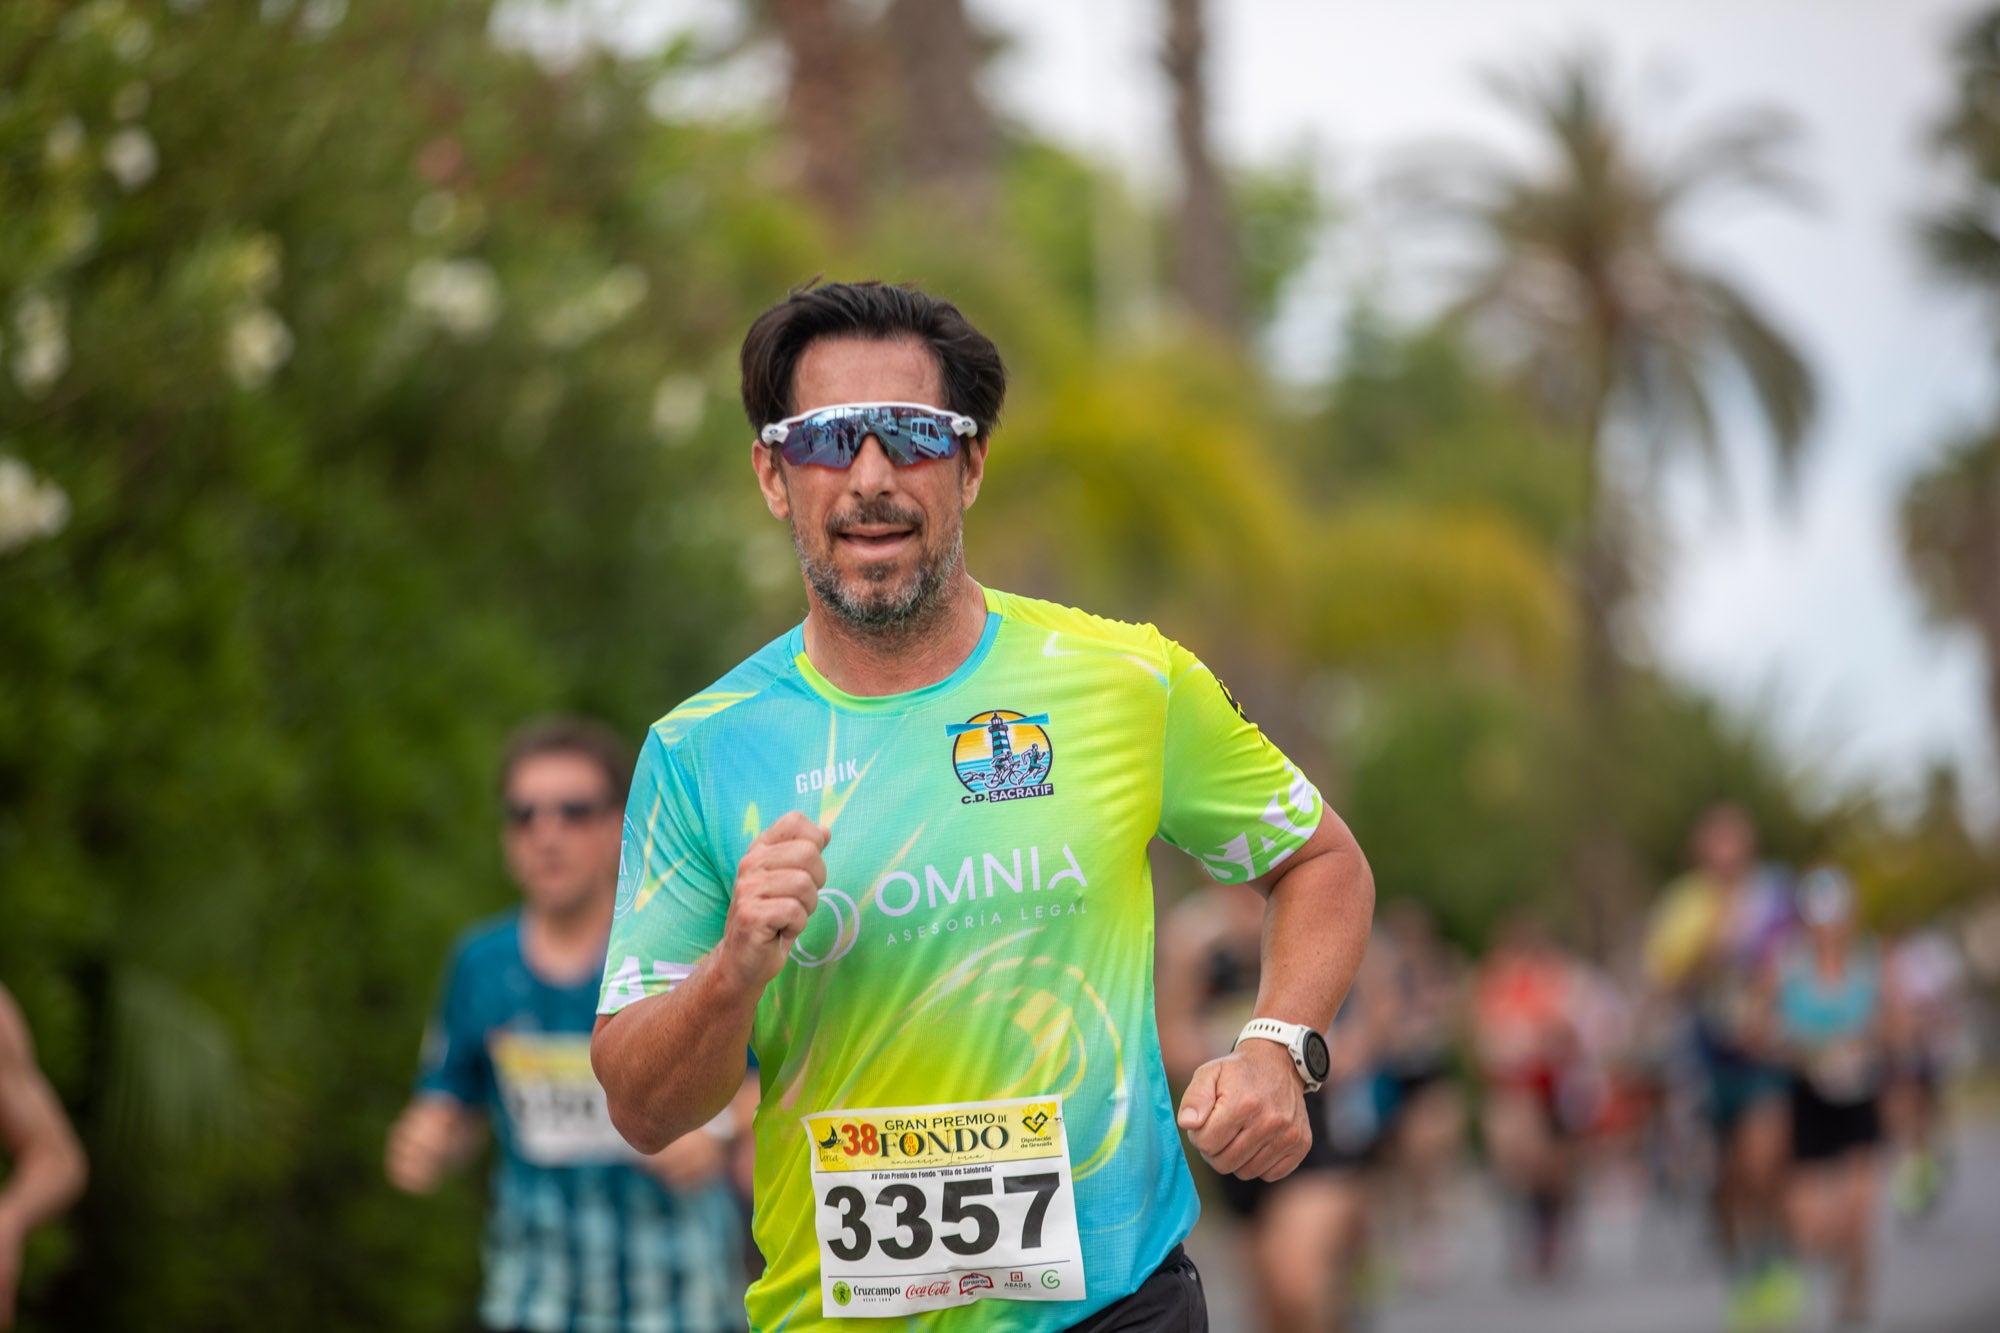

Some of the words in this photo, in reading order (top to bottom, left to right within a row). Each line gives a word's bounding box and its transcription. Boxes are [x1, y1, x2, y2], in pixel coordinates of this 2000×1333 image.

[796, 758, 858, 795] GOBIK
[961, 793, 988, 805] C.D.
[990, 785, 1053, 802] SACRATIF
[875, 843, 1088, 917] OMNIA
[887, 909, 1002, 947] ASESORÍA
[1020, 901, 1088, 921] LEGAL
[884, 1119, 927, 1131] GRAN
[933, 1113, 995, 1128] PREMIO
[841, 1123, 879, 1157] 38
[880, 1125, 1009, 1158] FONDO
[878, 1171, 890, 1180] Gran
[891, 1170, 909, 1180] Premio
[910, 1170, 917, 1178] de
[918, 1169, 936, 1178] Fondo
[954, 1167, 962, 1175] de
[824, 1172, 1060, 1262] 3357
[853, 1284, 901, 1298] Cruzcampo
[1004, 1281, 1032, 1289] ABADES
